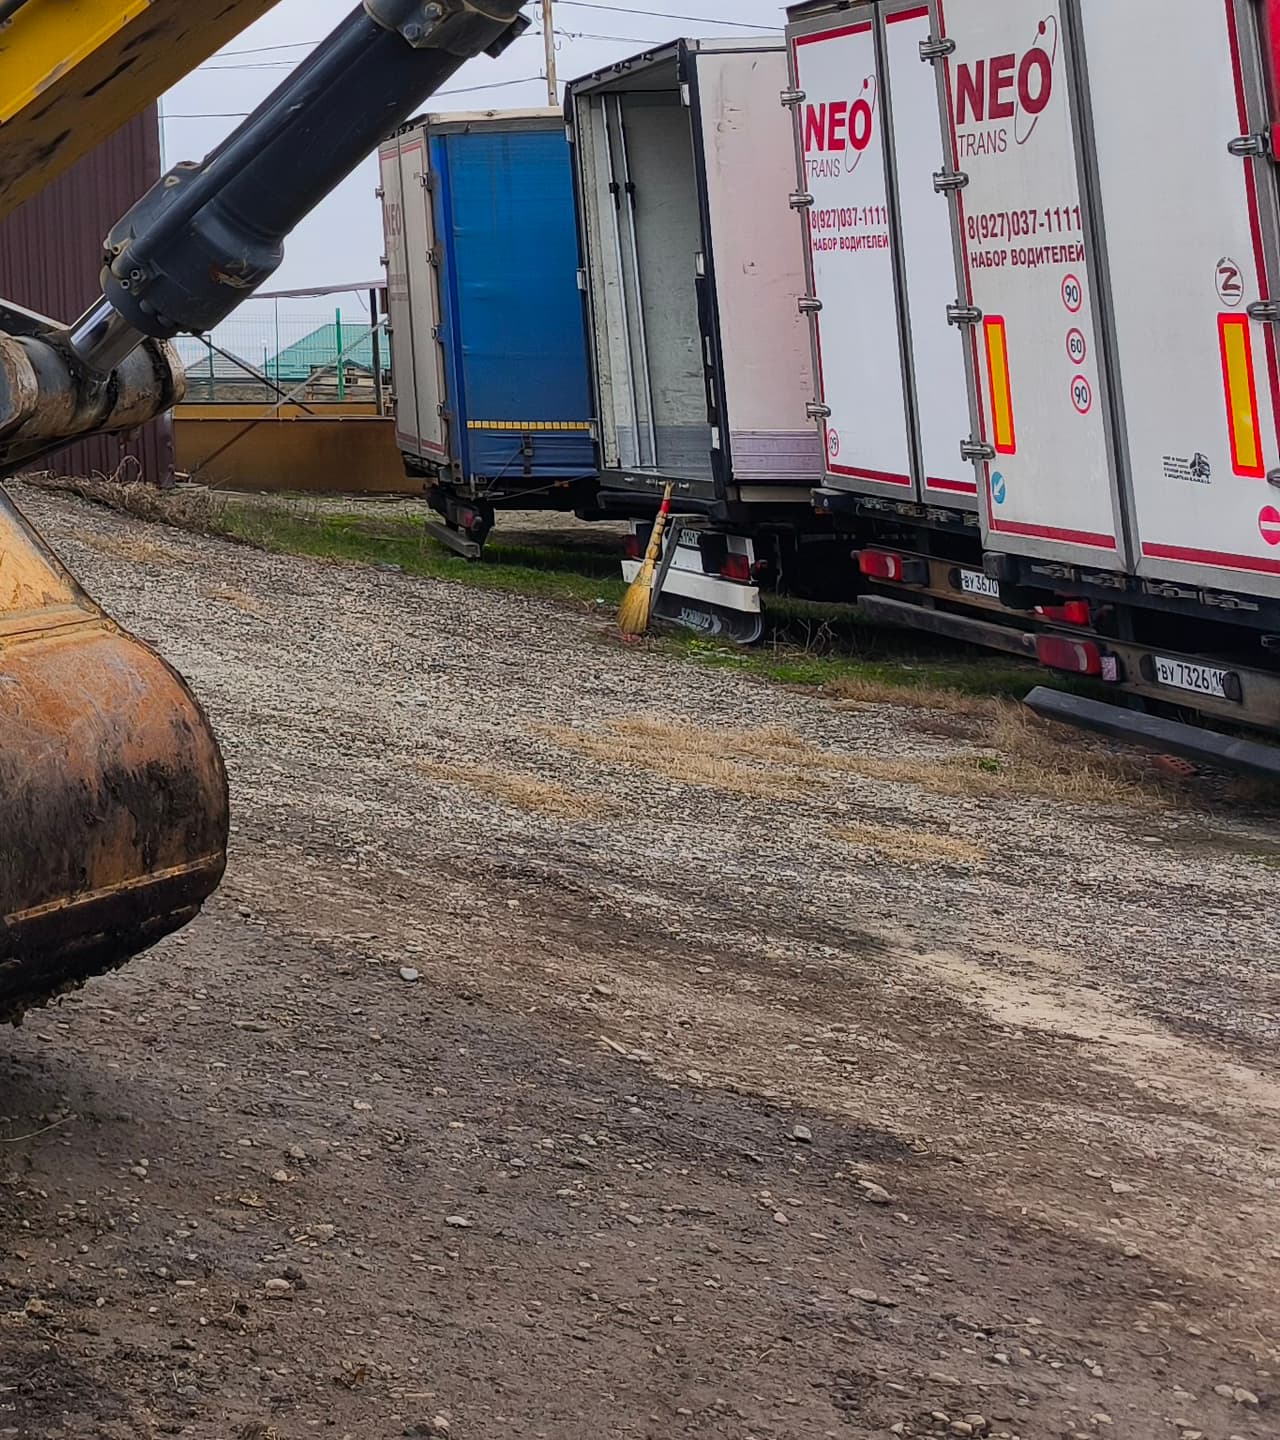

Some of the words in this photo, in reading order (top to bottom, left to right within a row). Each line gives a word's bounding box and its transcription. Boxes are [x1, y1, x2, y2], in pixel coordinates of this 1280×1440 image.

[956, 47, 1052, 125] NEO
[805, 98, 872, 152] NEO
[957, 128, 1008, 158] TRANS
[805, 158, 841, 179] TRANS
[811, 205, 888, 233] 8(927)037-1111
[967, 205, 1082, 244] 8(927)037-1111
[812, 236, 838, 252] НАБОР
[839, 231, 889, 252] ВОДИТЕЛЕЙ
[970, 249, 1008, 269] НАБОР
[1010, 240, 1086, 268] ВОДИТЕЛЕЙ
[1064, 284, 1079, 303] 90
[1069, 337, 1083, 355] 60
[1073, 384, 1089, 406] 90
[1176, 663, 1210, 690] 7326
